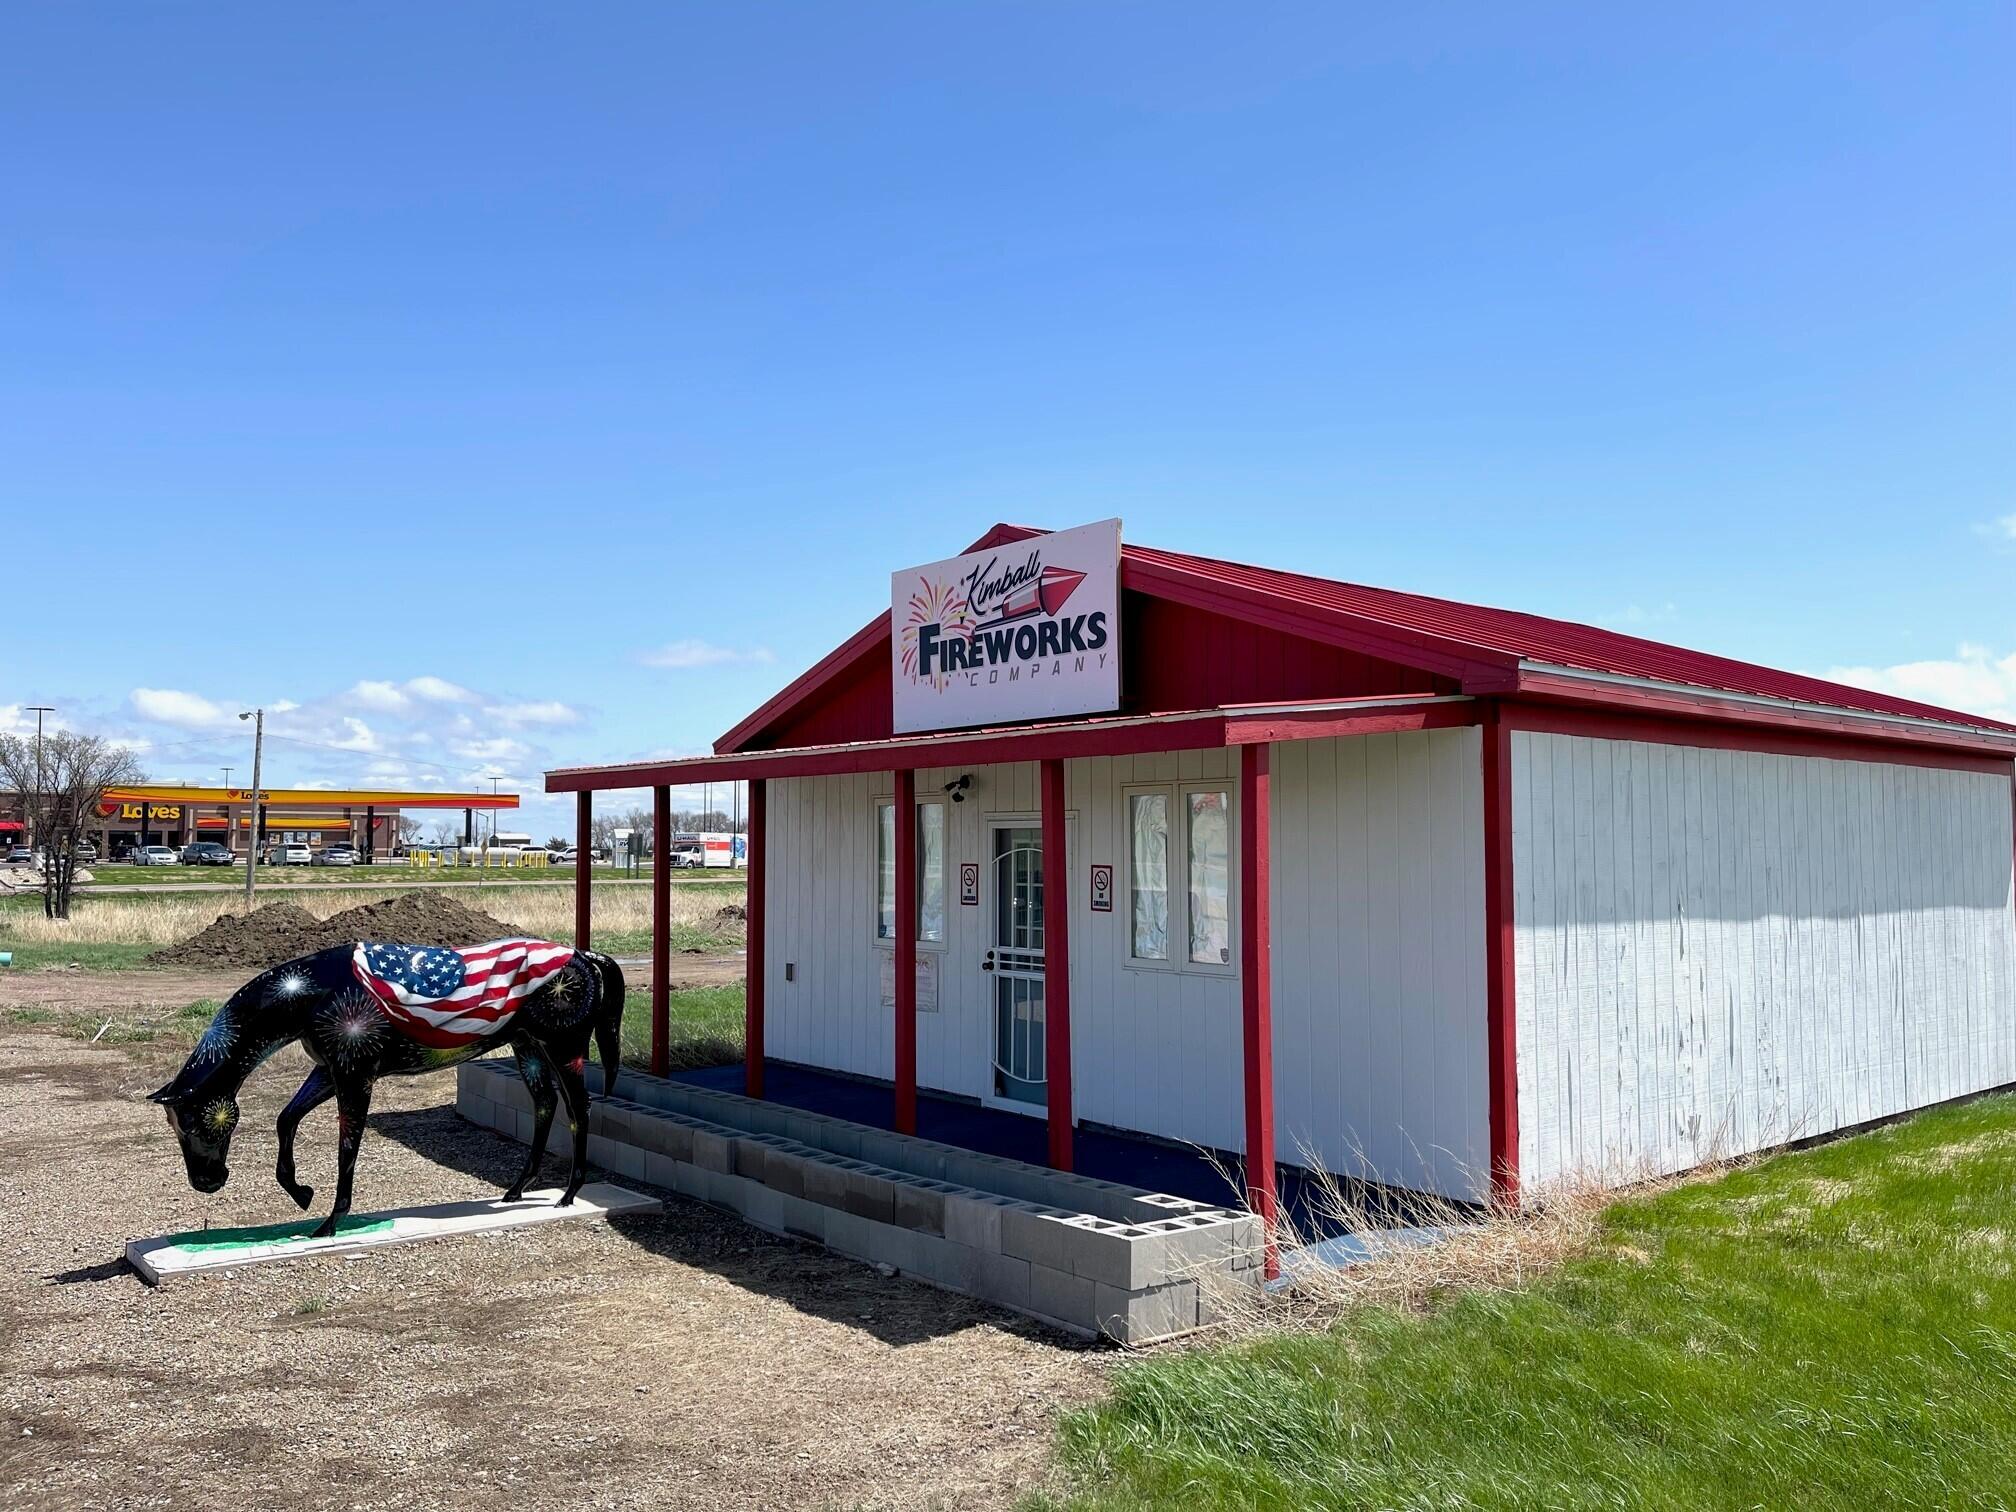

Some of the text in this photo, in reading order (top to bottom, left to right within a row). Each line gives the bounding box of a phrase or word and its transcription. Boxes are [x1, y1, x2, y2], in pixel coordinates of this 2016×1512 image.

[963, 550, 1041, 618] Kimball
[918, 611, 1107, 676] FIREWORKS
[969, 653, 1107, 687] COMPANY
